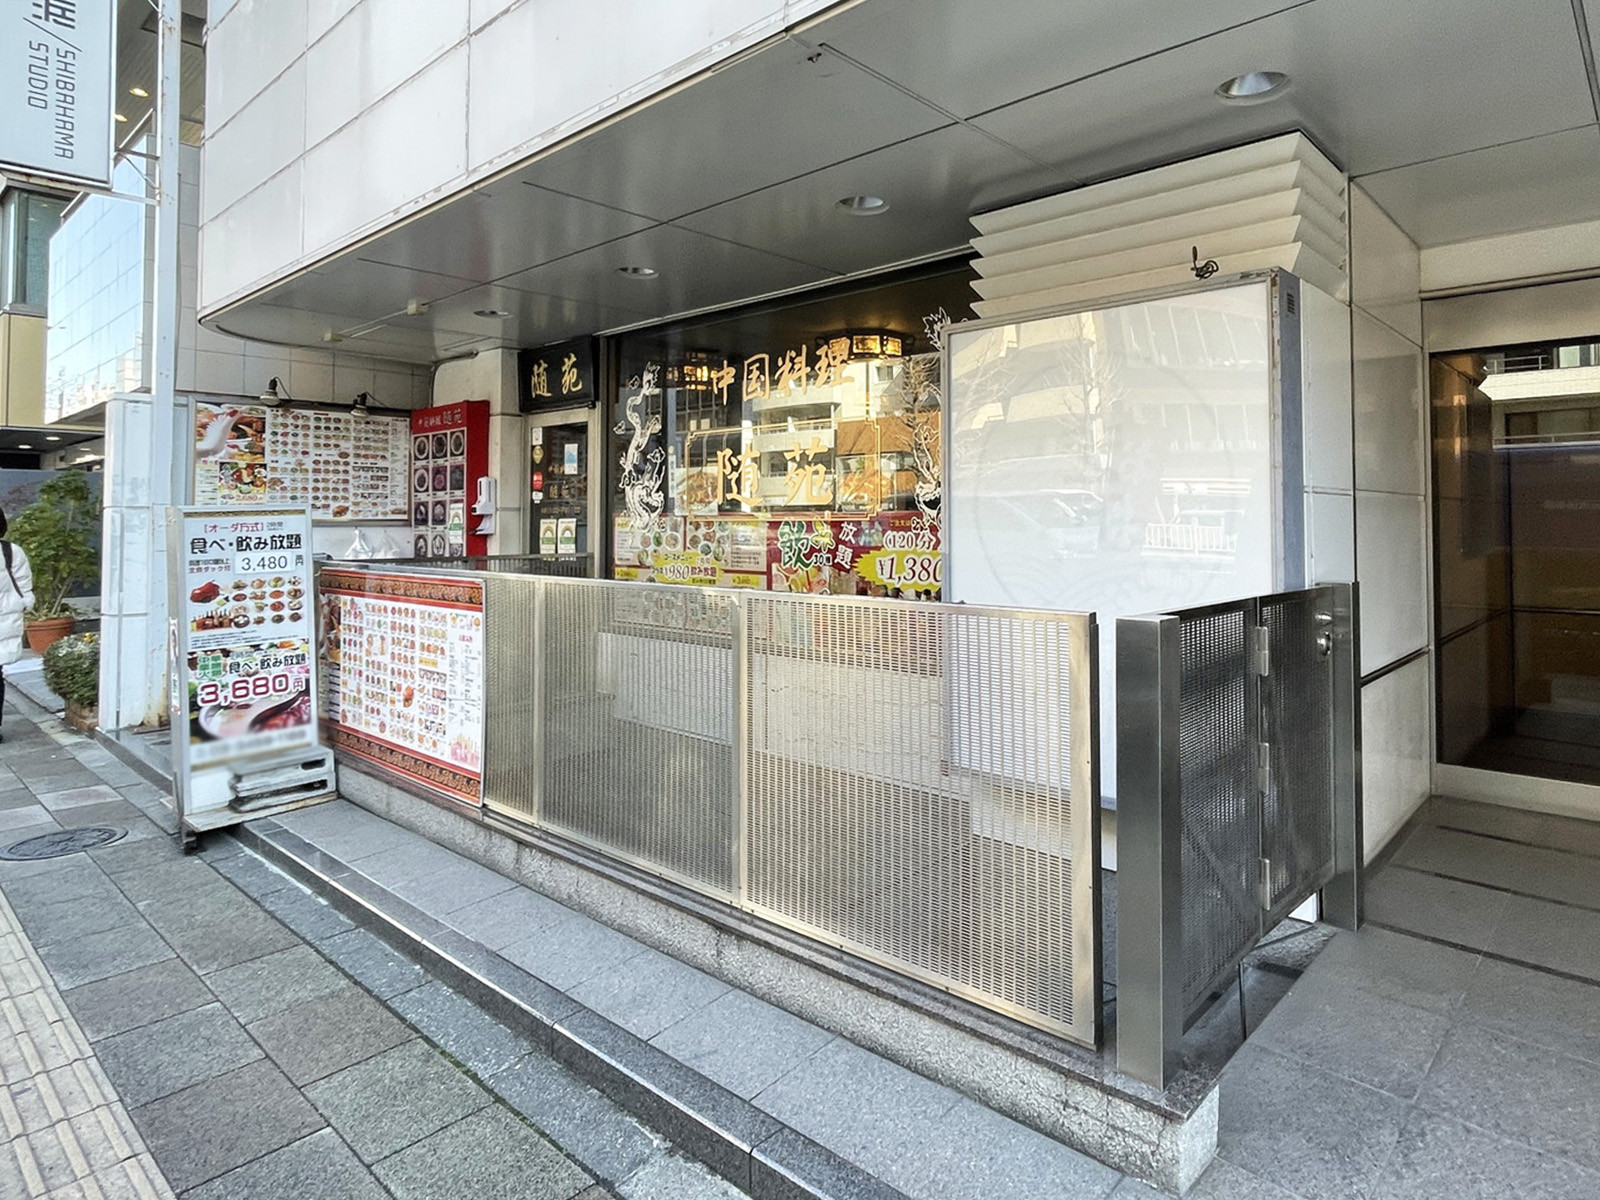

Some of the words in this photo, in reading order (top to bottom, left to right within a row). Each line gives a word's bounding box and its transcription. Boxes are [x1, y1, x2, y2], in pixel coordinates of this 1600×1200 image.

[28, 41, 50, 110] STUDIO
[55, 48, 77, 160] SHIBAHAMA
[530, 352, 583, 399] 随苑
[710, 337, 855, 406] 中国料理
[716, 436, 834, 508] 随苑
[190, 533, 302, 555] 食べ・飲み放題
[241, 555, 288, 572] 3,480
[229, 653, 306, 674] 食べ・飲み放題
[200, 673, 289, 704] 3,680
